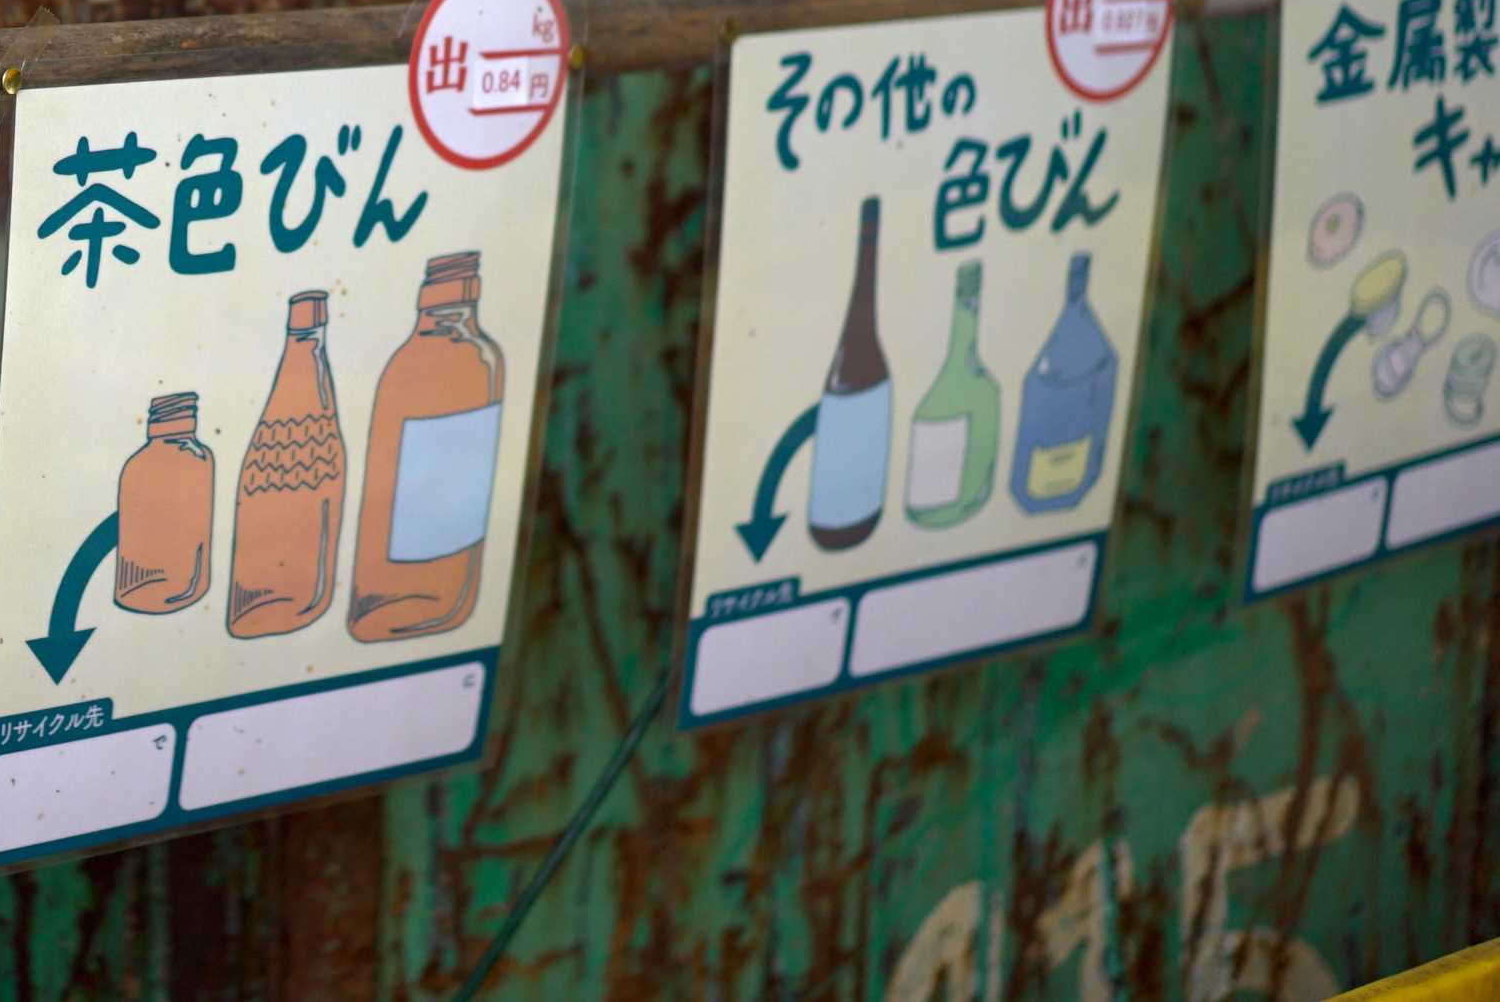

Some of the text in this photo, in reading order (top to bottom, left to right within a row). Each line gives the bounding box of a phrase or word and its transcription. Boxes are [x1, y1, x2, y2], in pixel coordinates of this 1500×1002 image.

[426, 36, 549, 97] 出 0.84 円
[532, 13, 555, 43] kg
[766, 50, 977, 171] その他の
[36, 124, 429, 289] 茶色びん
[933, 108, 1121, 251] 色びん
[0, 704, 104, 745] リサイクル先
